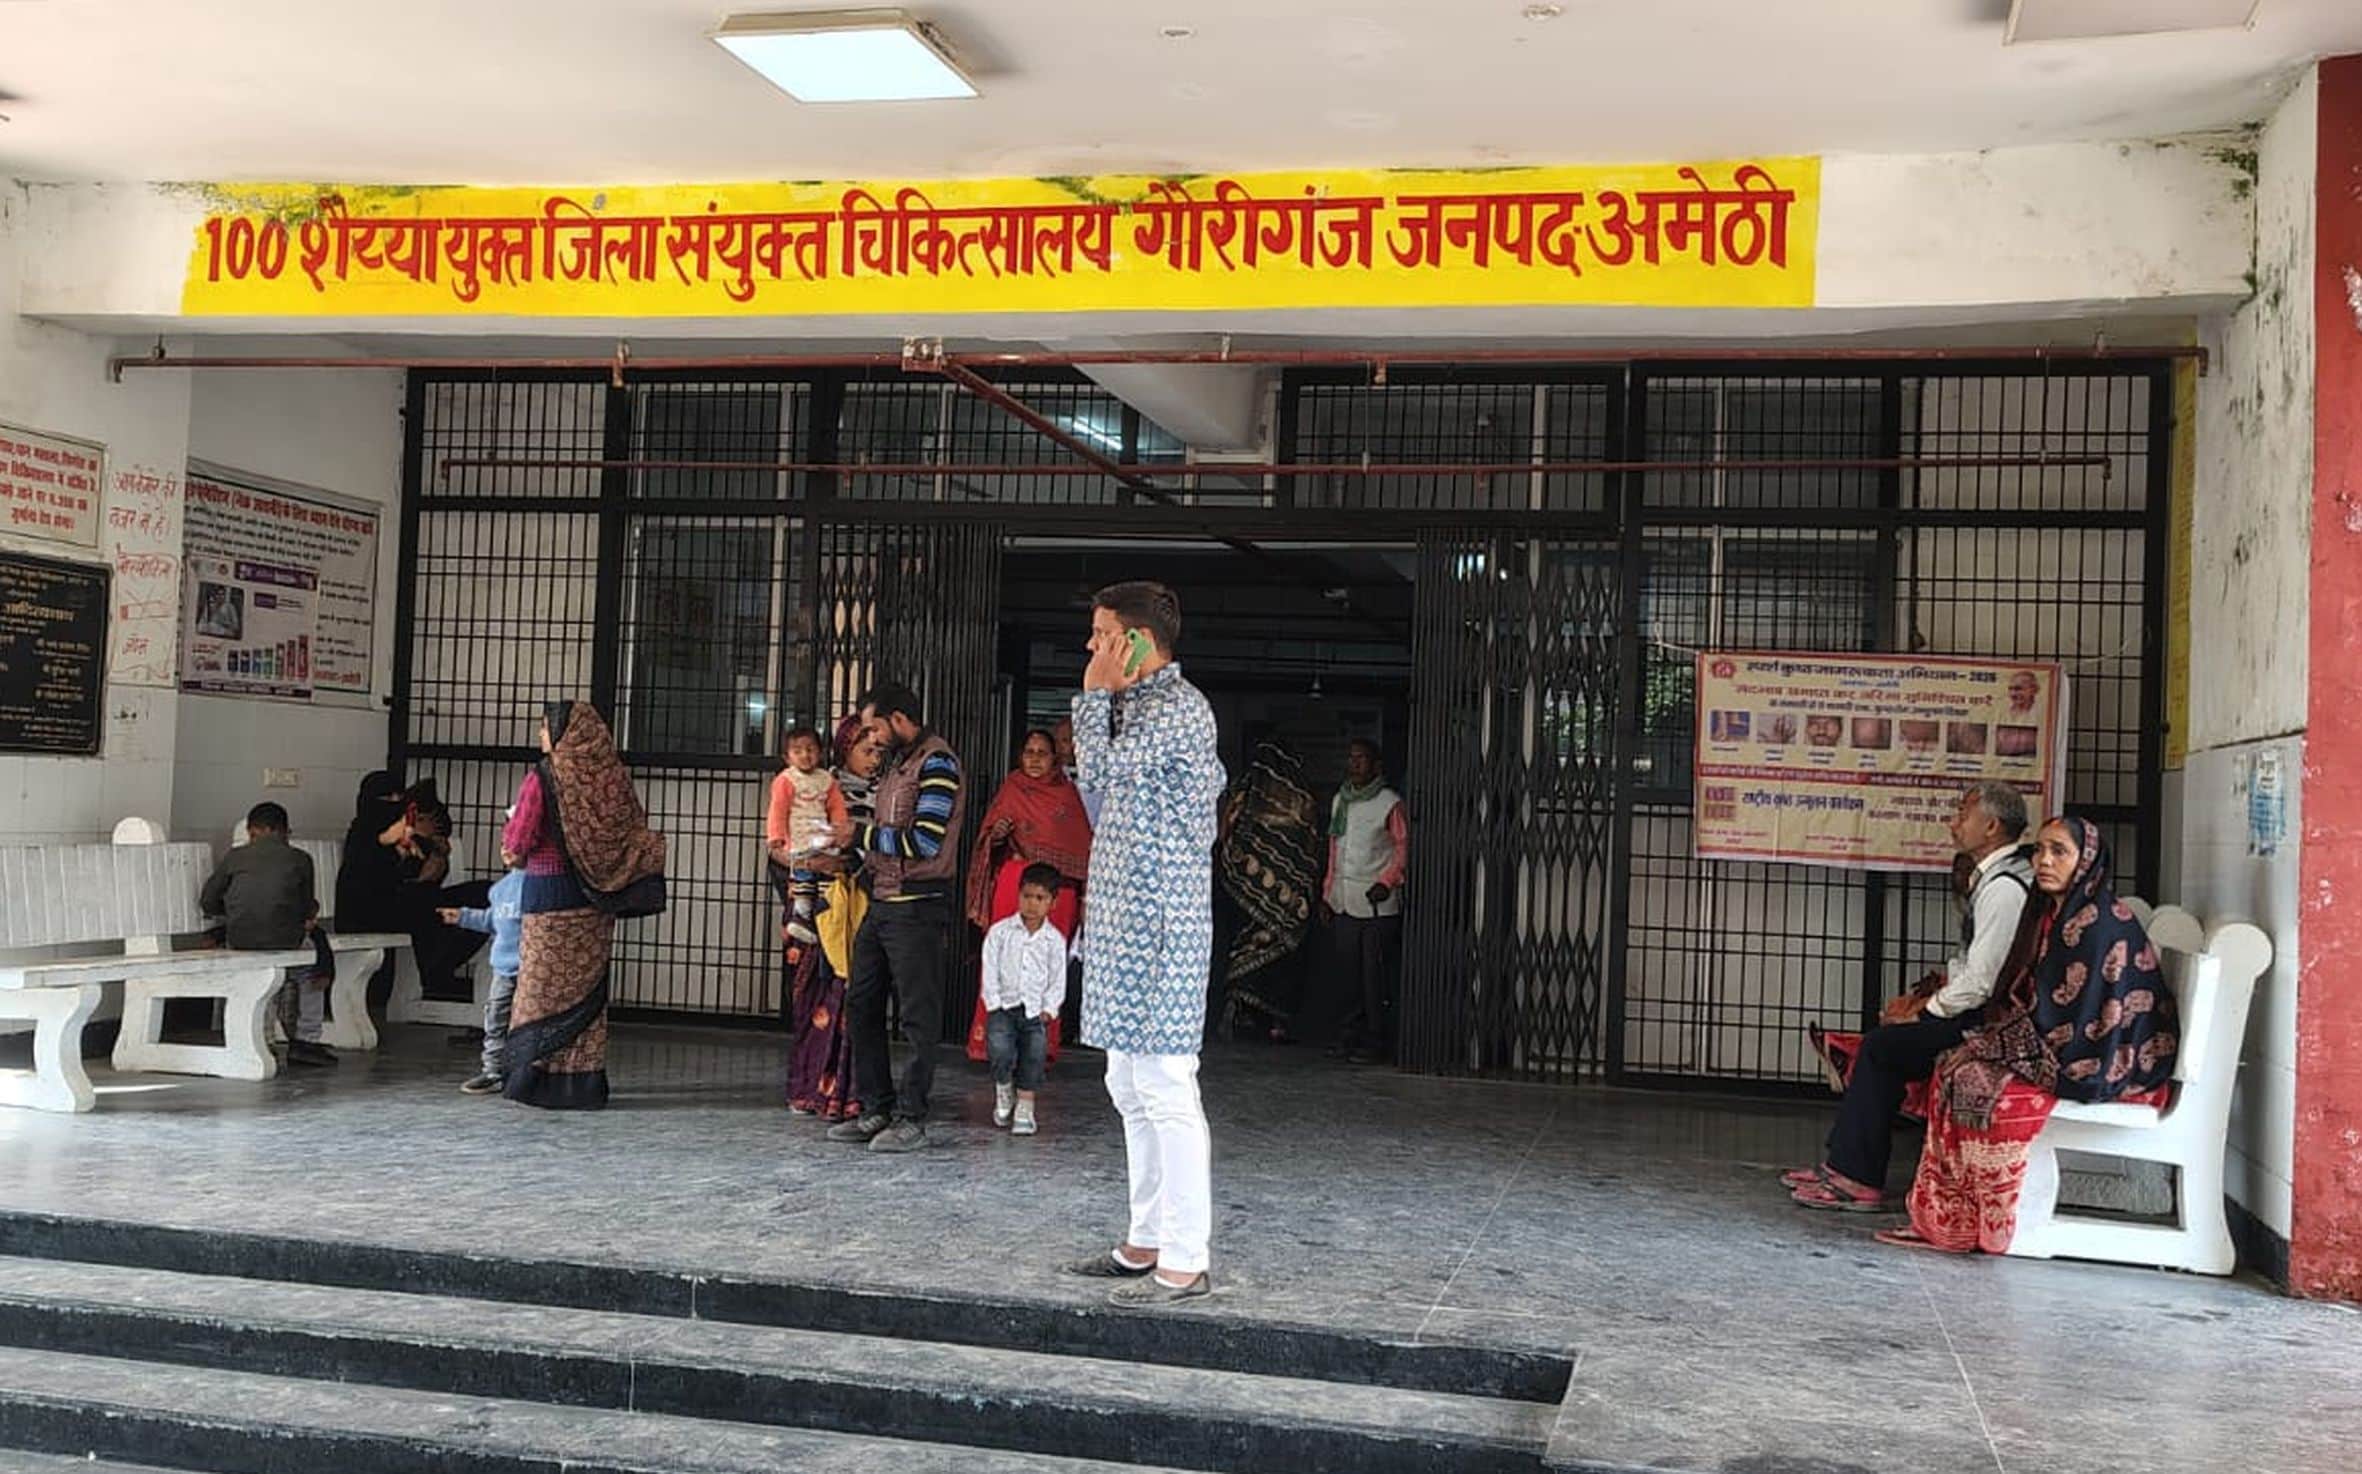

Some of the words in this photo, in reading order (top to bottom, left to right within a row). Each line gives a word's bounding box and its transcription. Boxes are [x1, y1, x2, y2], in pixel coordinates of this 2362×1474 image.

[205, 216, 289, 282] 100
[444, 217, 538, 303] युक्त
[539, 196, 665, 286] जिला
[665, 201, 836, 303] संयुक्त
[837, 187, 1120, 279] चिकित्सालय
[1132, 180, 1384, 272] गौरीगंज
